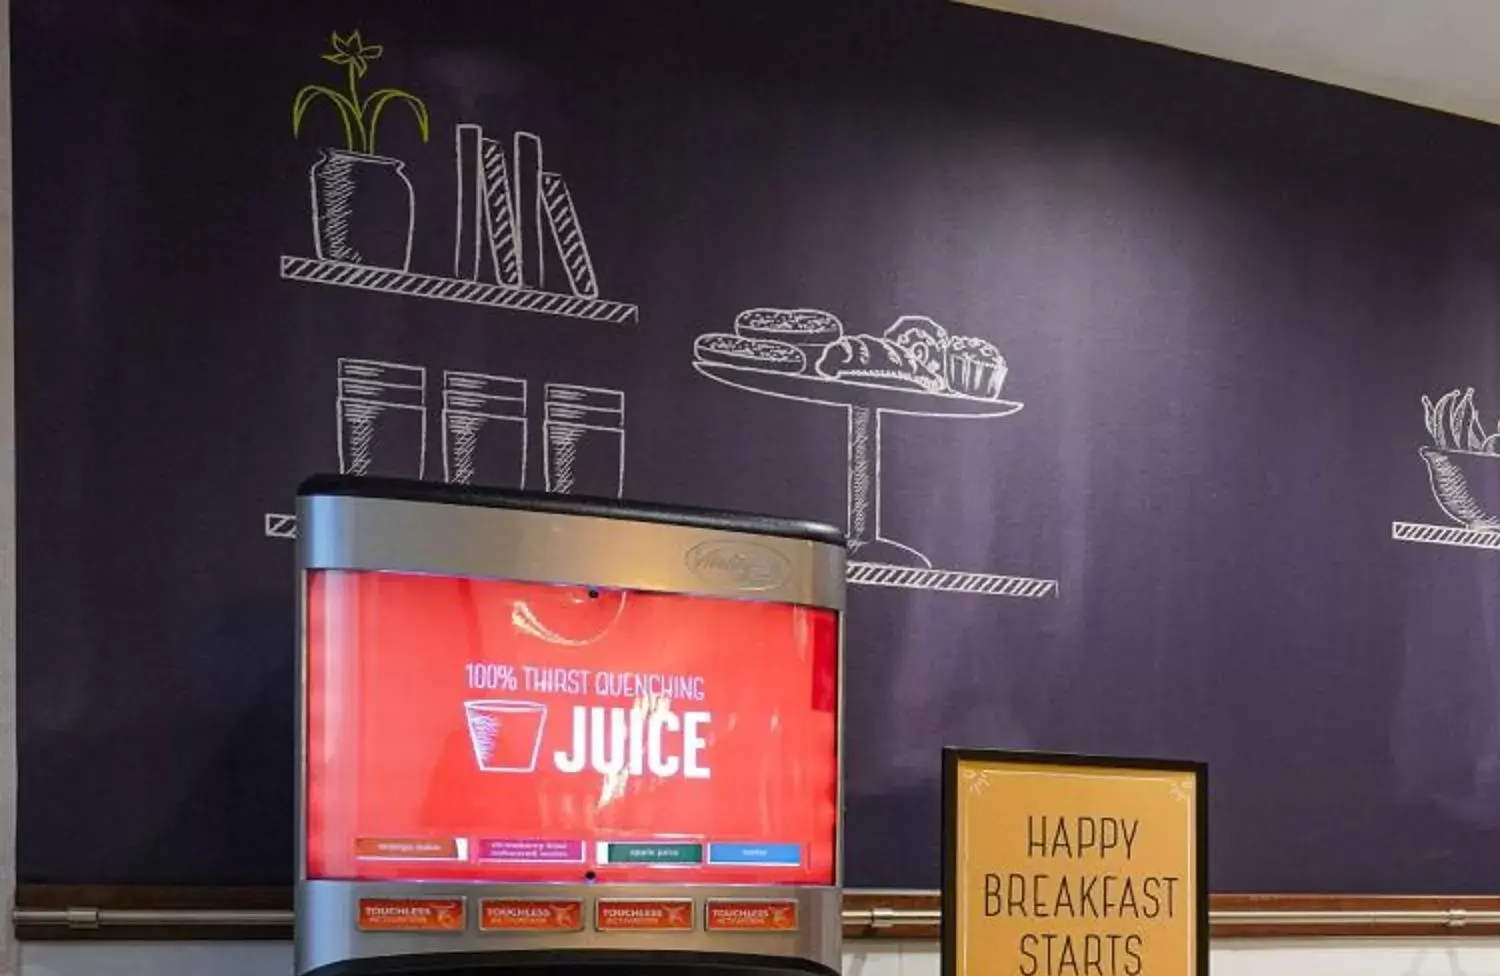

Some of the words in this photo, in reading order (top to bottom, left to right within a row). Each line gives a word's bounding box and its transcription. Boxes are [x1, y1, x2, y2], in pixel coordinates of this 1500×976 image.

[465, 663, 517, 691] 100%
[522, 666, 590, 694] THIRST
[595, 671, 705, 701] QUENCHING
[553, 705, 712, 780] JUICE
[1027, 815, 1139, 860] HAPPY
[366, 906, 430, 916] TOUCHLESS
[487, 907, 550, 917] TOUCHLESS
[603, 908, 662, 917] TOUCHLESS
[712, 908, 769, 918] TOUCHLESS
[984, 873, 1179, 919] BREAKFAST
[1019, 933, 1143, 976] STARTS
